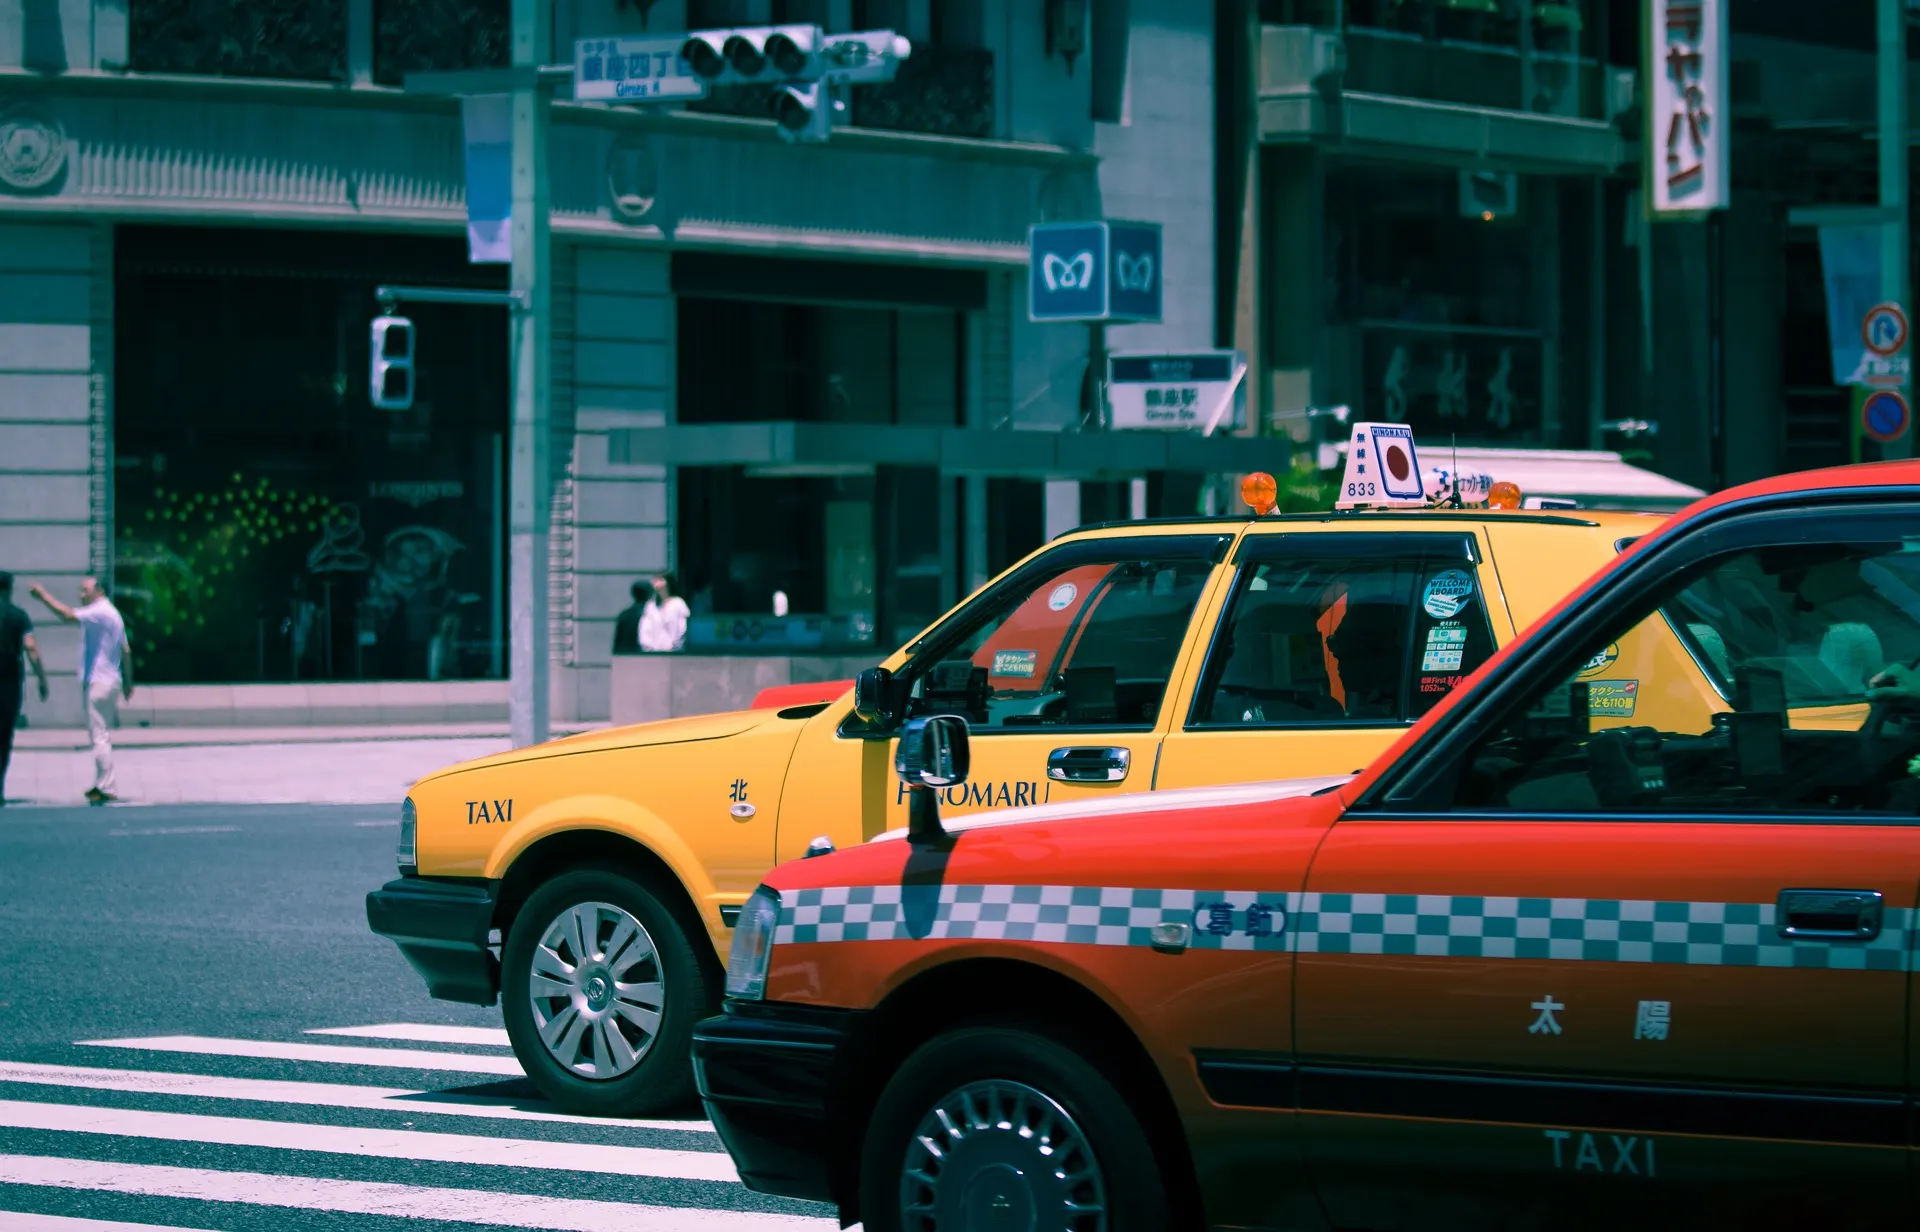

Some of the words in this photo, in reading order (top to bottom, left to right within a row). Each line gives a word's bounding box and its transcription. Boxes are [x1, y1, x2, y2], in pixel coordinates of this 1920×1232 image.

[1371, 428, 1411, 438] HINOMARU
[1347, 482, 1376, 497] 833
[1430, 580, 1471, 588] WELCOME
[1429, 587, 1468, 596] ABOARD!
[1589, 686, 1625, 696] タクシー
[1588, 697, 1634, 709] こども110番
[729, 778, 748, 802] 北
[897, 782, 1050, 807] HOMARU
[465, 799, 513, 825] TAXI
[1543, 1129, 1657, 1177] TAXI
